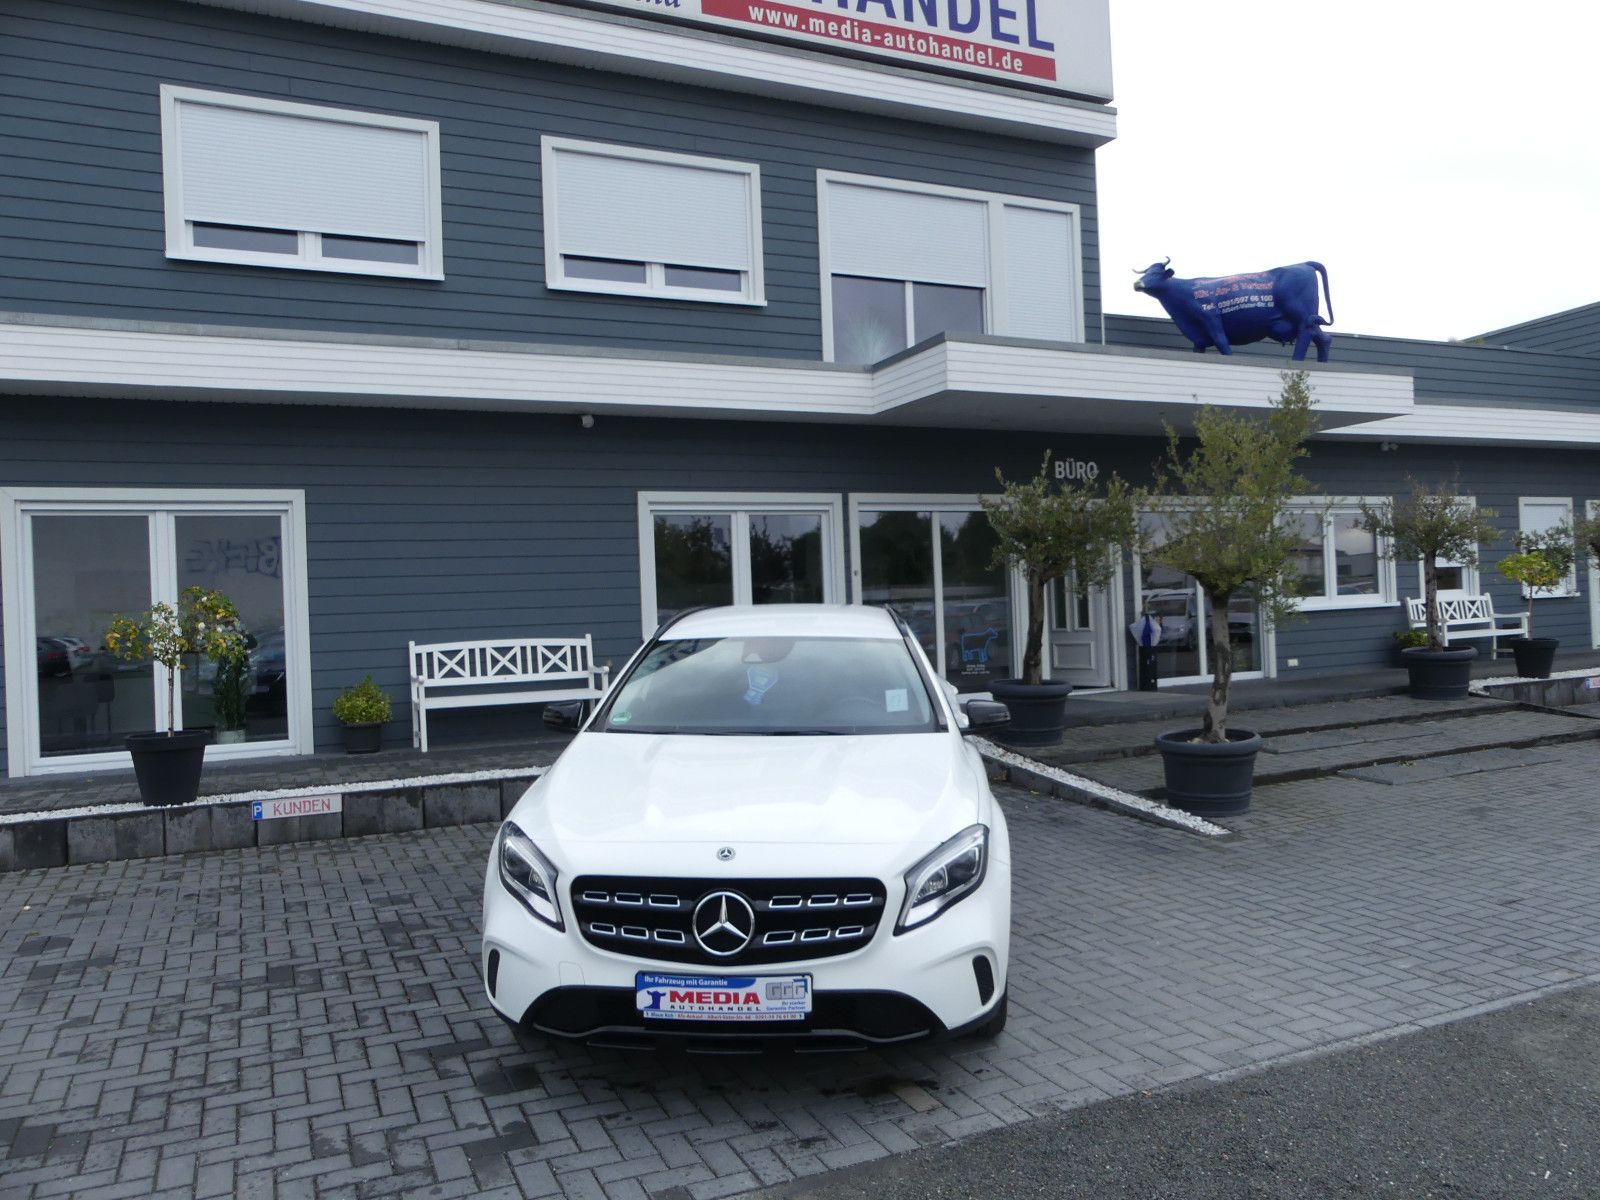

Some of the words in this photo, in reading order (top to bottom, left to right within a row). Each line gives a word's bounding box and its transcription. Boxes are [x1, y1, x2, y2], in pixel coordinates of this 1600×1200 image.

[812, 0, 1055, 52] NDEL
[748, 3, 1023, 73] www.media-autohandel.de
[1054, 457, 1098, 480] BÜRO
[253, 804, 262, 817] P
[272, 798, 331, 816] KUNDEN
[644, 975, 654, 984] Ihr
[654, 976, 685, 987] Fahrzeug
[686, 978, 698, 986] mit
[698, 979, 728, 987] Garantie
[669, 990, 760, 1005] MEDIA
